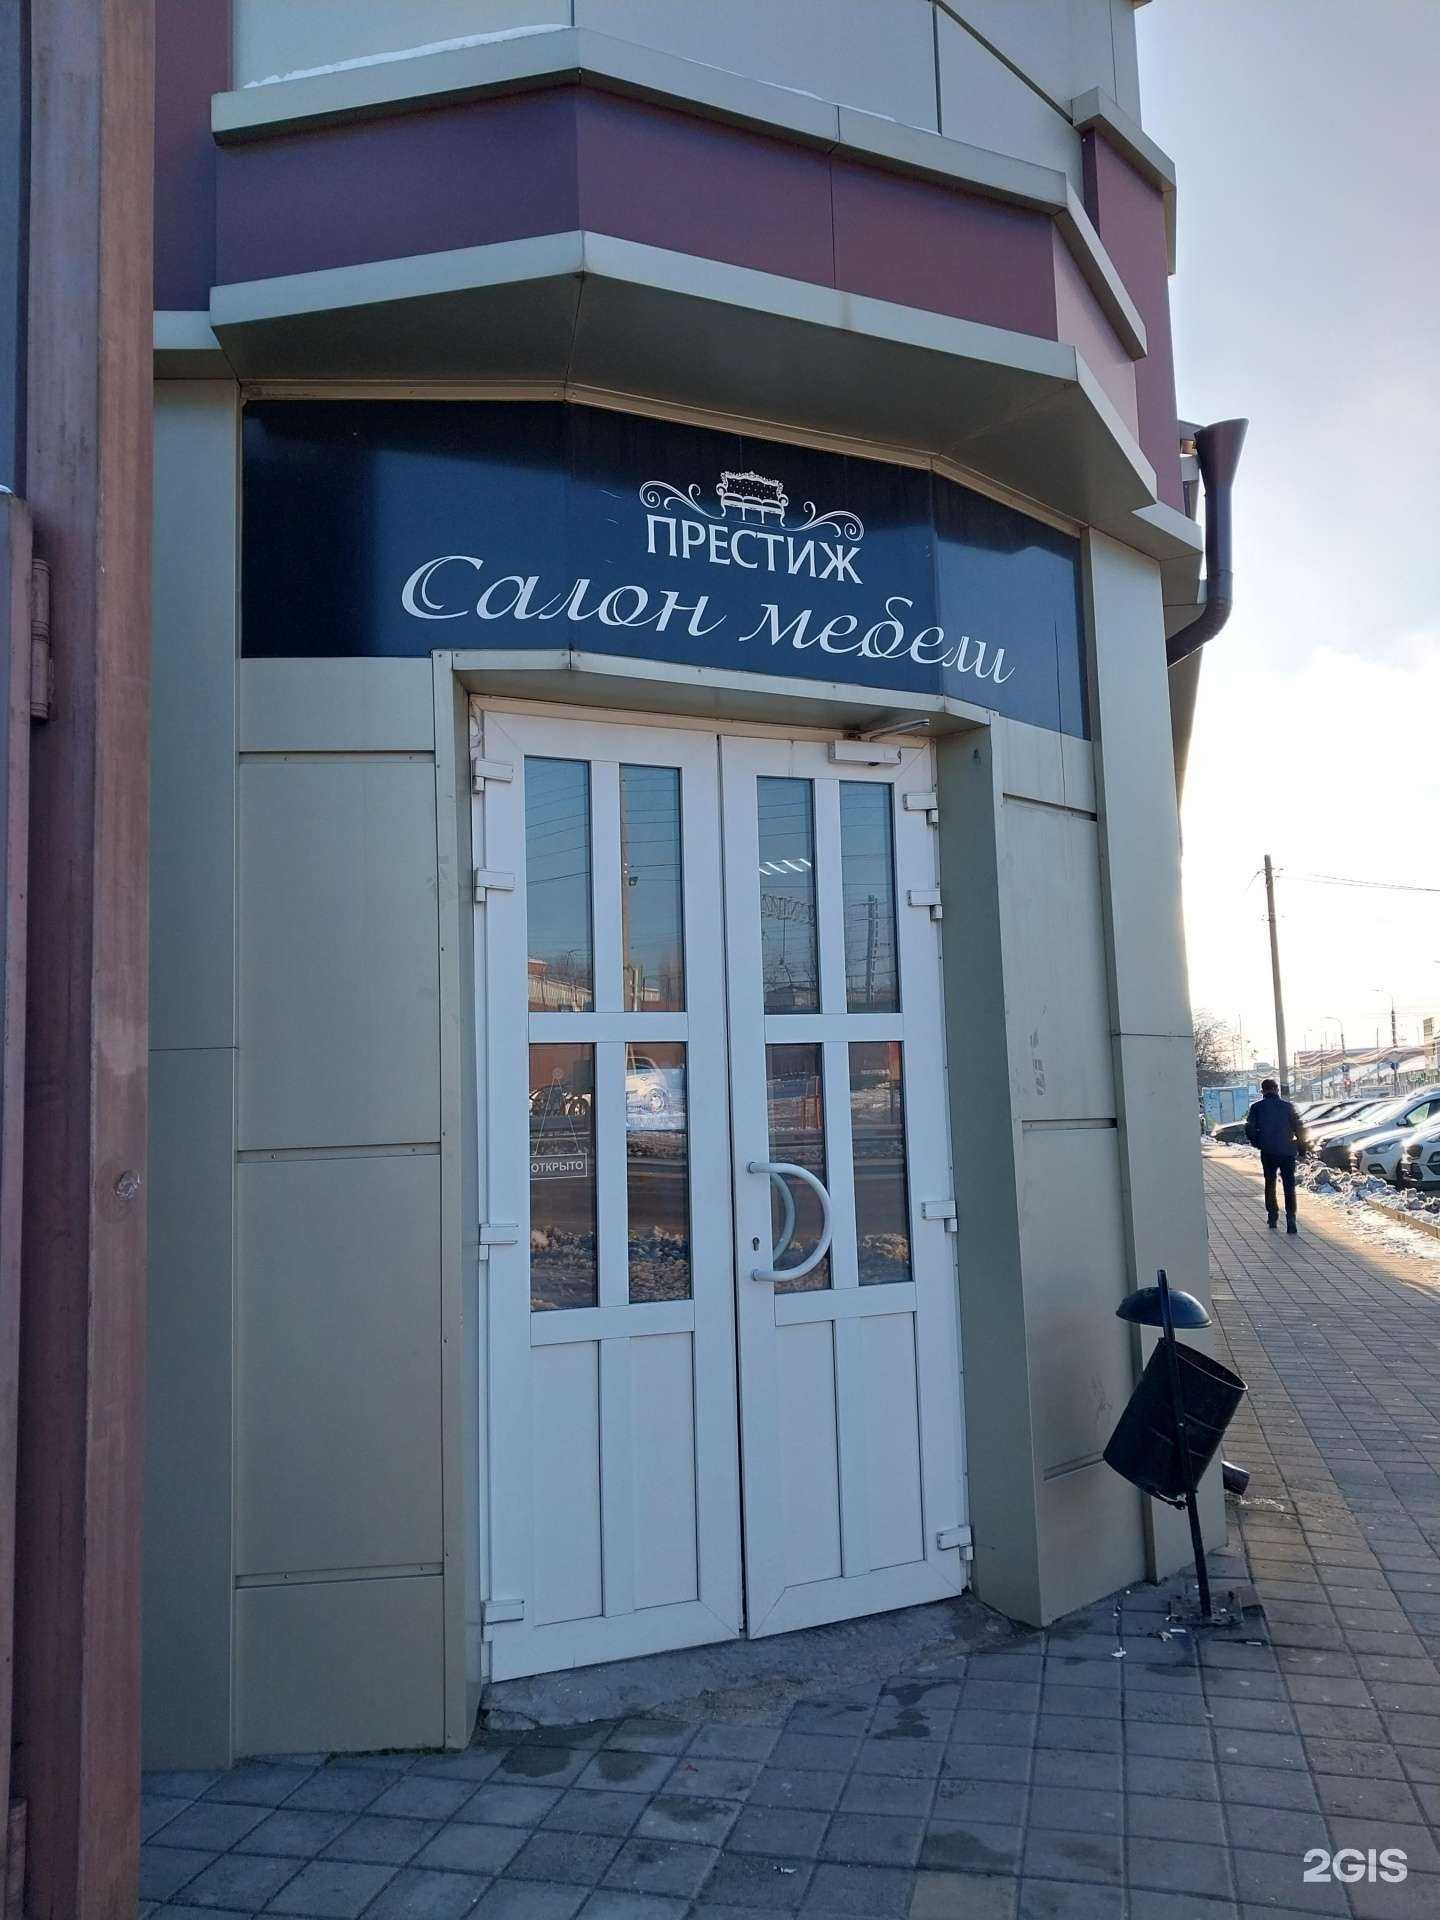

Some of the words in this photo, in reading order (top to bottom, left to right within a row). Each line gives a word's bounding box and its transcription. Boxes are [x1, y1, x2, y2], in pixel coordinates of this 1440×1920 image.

[647, 513, 863, 585] ПРЕСТИЖ
[401, 555, 728, 638] Салон
[738, 596, 1015, 685] мебели
[531, 1161, 584, 1173] ОТКРЫТО
